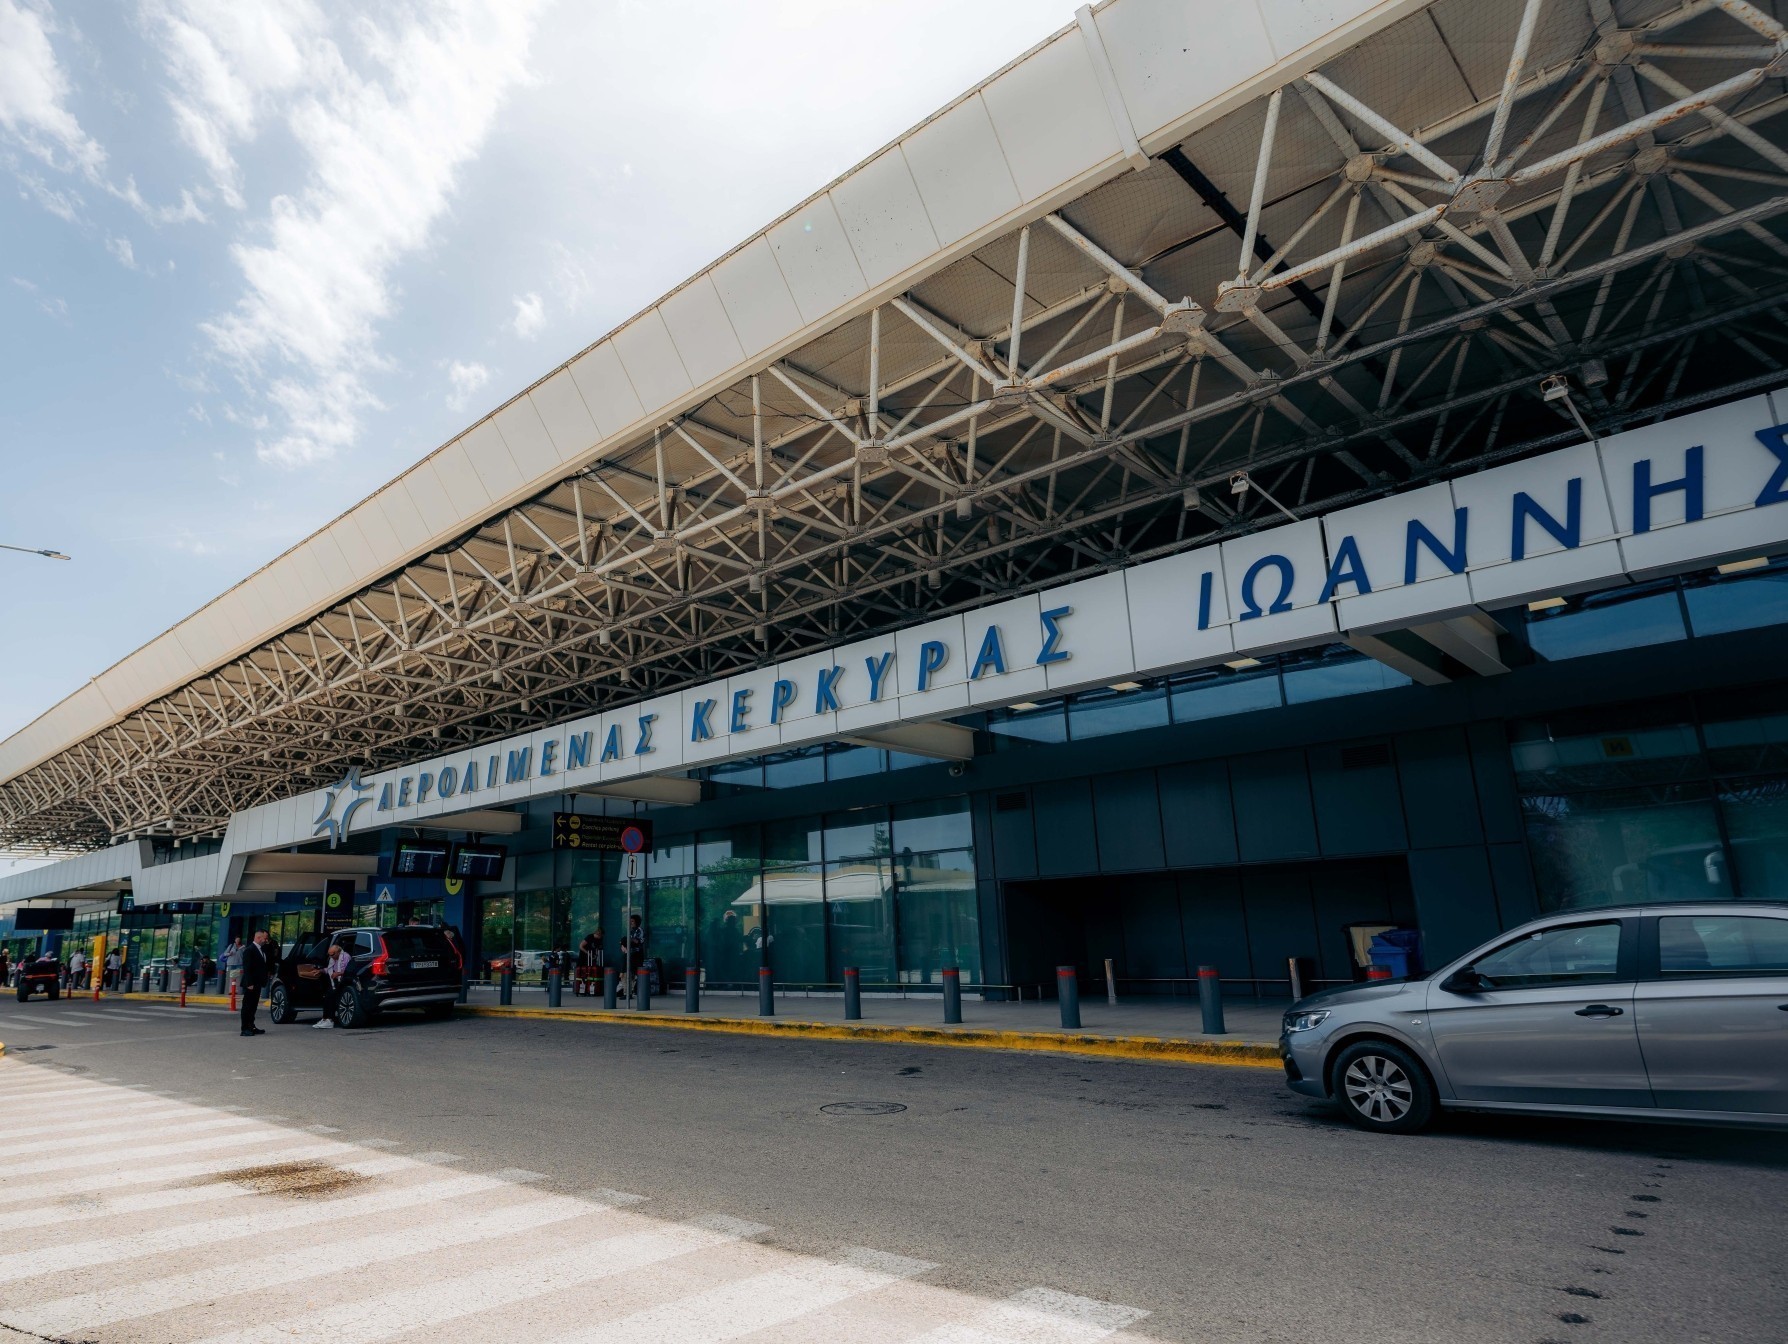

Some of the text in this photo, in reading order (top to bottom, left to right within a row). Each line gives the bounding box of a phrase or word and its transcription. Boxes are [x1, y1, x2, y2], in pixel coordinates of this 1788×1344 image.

[377, 713, 658, 811] ΑΕΡΟΛΙΜΕΝΑΣ
[691, 605, 1074, 742] ΚΕΡΚΥΡΑΣ
[331, 896, 338, 904] B
